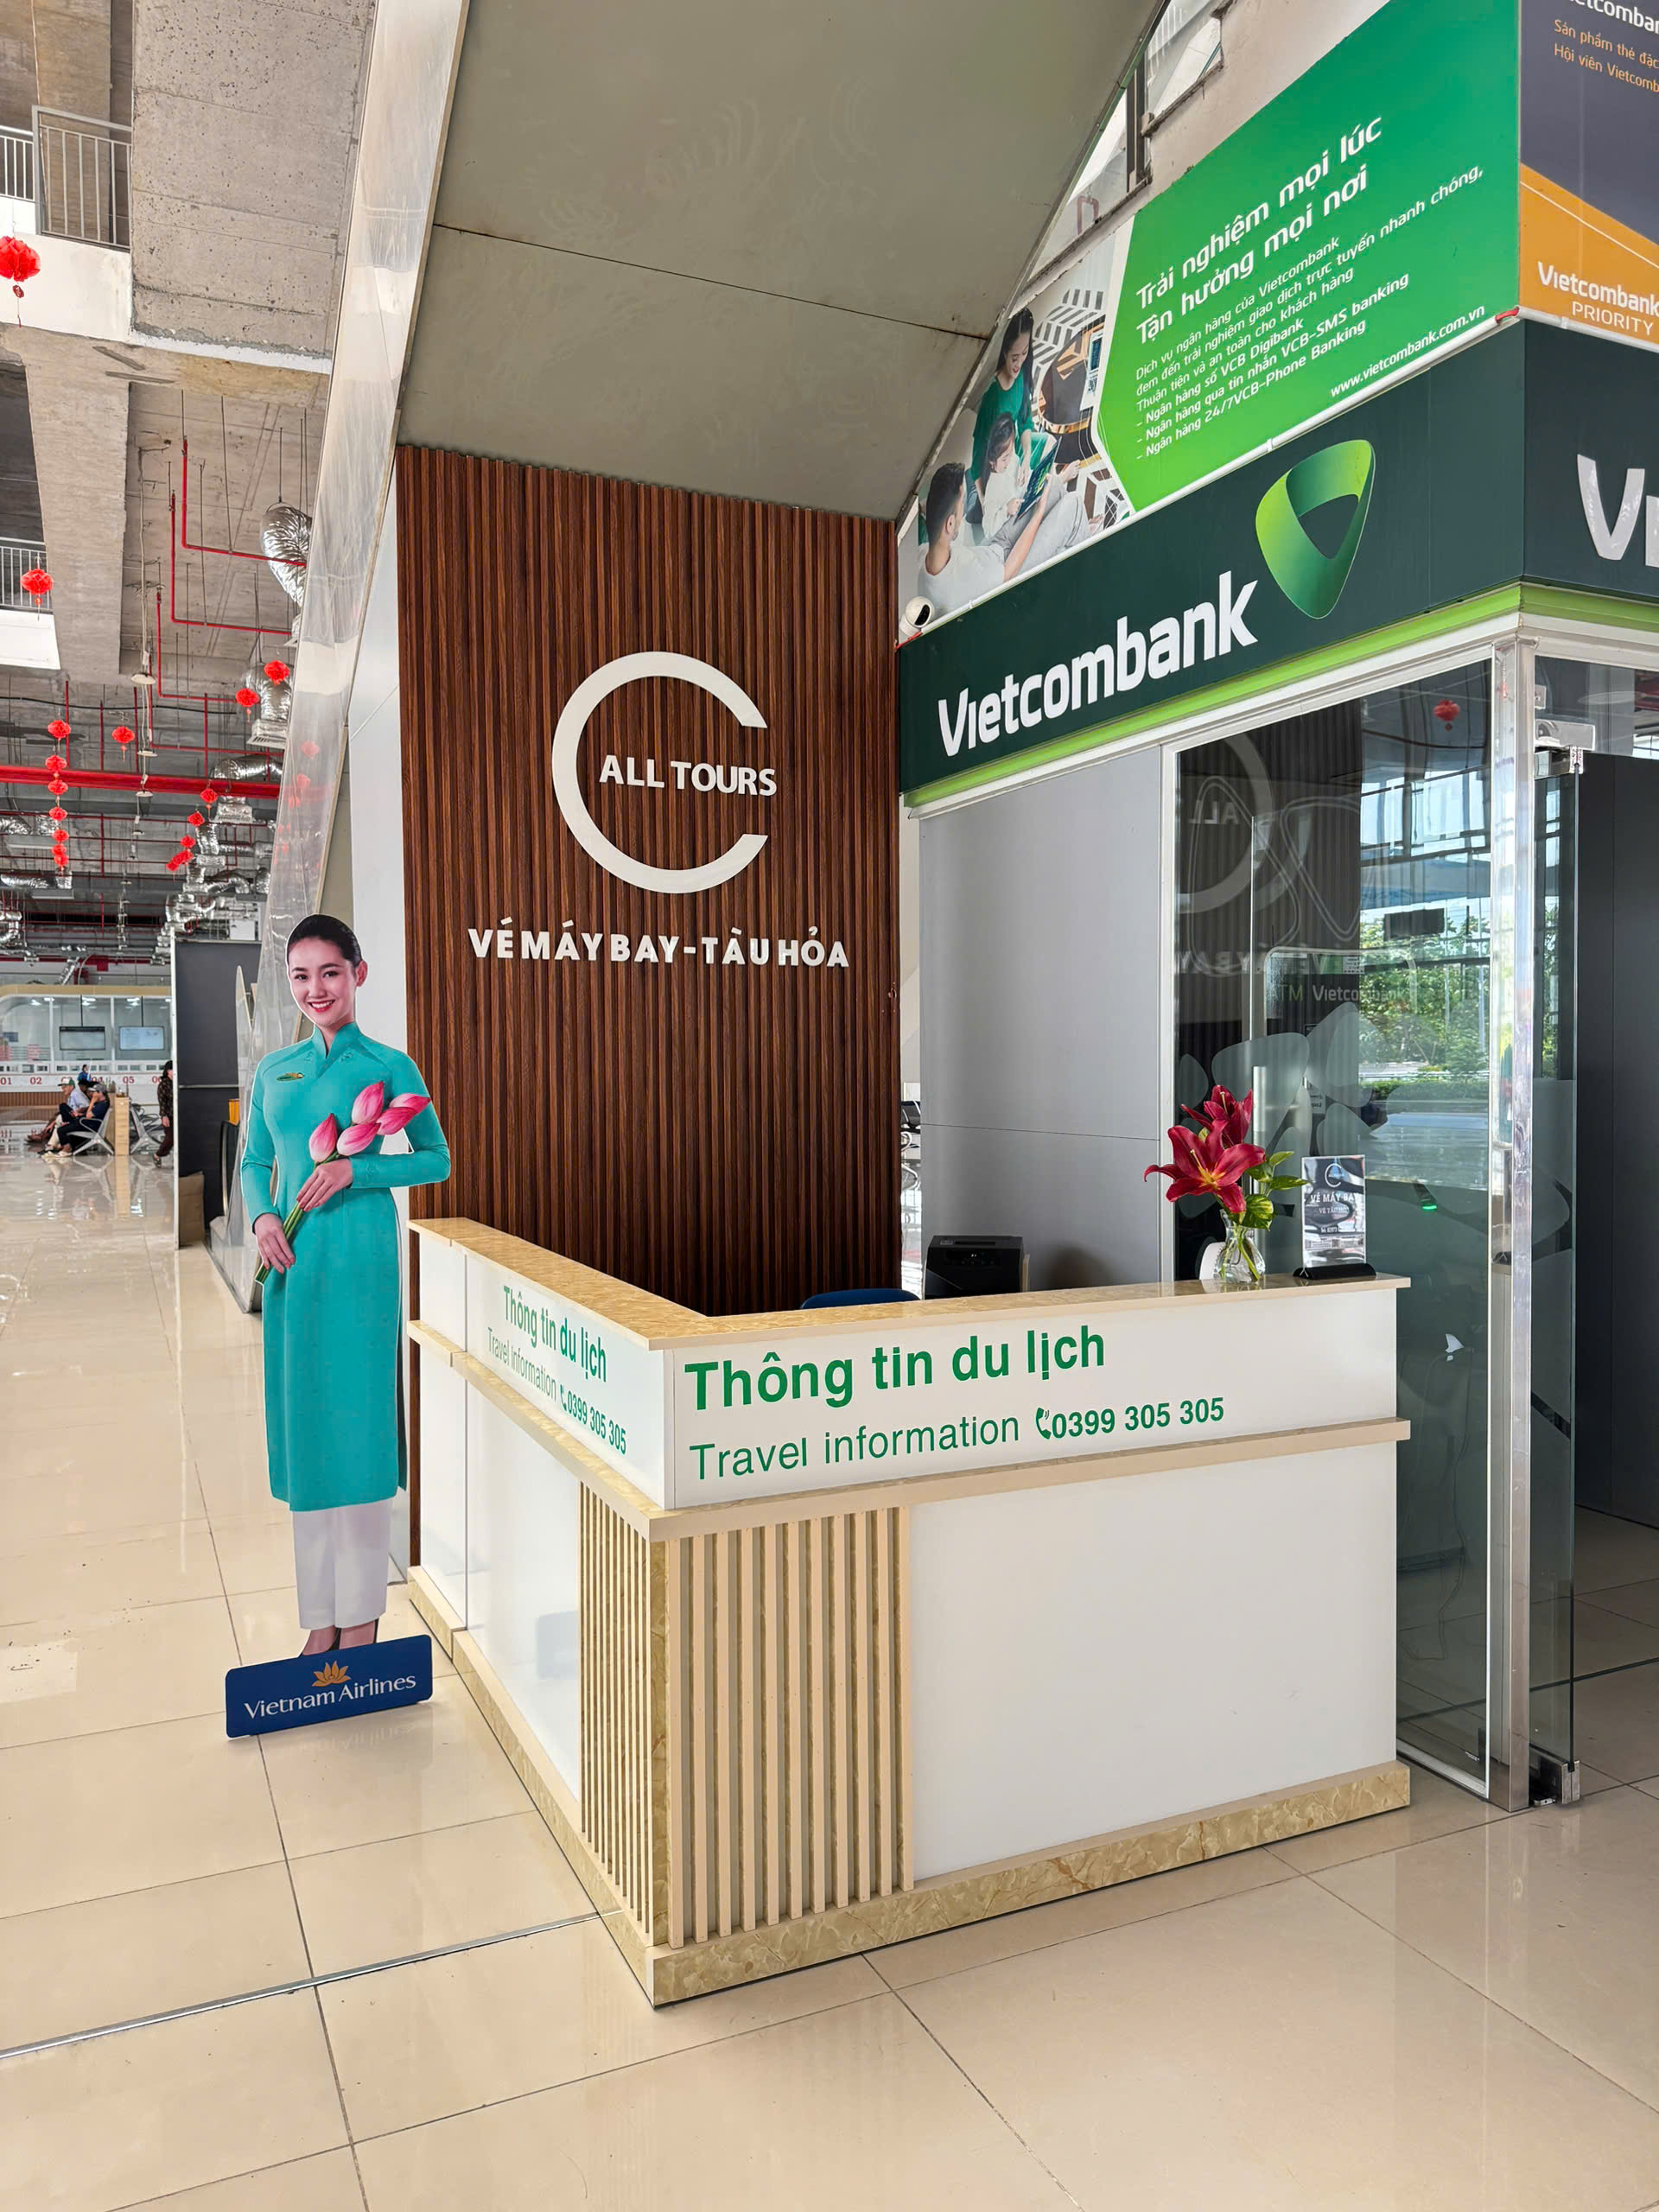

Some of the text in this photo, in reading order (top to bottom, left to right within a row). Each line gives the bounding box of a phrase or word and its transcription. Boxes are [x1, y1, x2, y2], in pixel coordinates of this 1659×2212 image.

[1554, 19, 1576, 39] Sản
[1580, 31, 1613, 52] phẩm
[1617, 43, 1636, 60] thẻ
[1554, 42, 1574, 62] Hội
[1578, 54, 1603, 73] viên
[1136, 117, 1382, 308] Trải nghiệm mọi lúc
[1136, 163, 1367, 344] Tận hưởng mọi nơi
[1136, 165, 1484, 396] đem đến trải nghiệm giao dịch trực tuyến nhanh chóng,
[1136, 237, 1339, 380] Dịch vụ ngân hàng của Vietcombank
[1537, 260, 1659, 317] Vietcombank
[1572, 301, 1654, 336] PRIORITY
[1136, 267, 1353, 411] Thuận tiện và an toàn cho khách hàng
[1146, 419, 1172, 441] Ngân
[1175, 400, 1201, 423] hàng
[1205, 386, 1224, 405] qua
[1228, 375, 1243, 391] tin
[1248, 354, 1277, 379] nhắn
[1351, 273, 1409, 316] banking
[1146, 402, 1172, 423] Ngân
[1175, 383, 1201, 406] hàng
[1205, 367, 1217, 388] số
[1221, 353, 1245, 376] VCB
[1250, 318, 1304, 359] Digibank
[1331, 305, 1485, 397] www.vietcombank.com.vn
[1146, 435, 1172, 457] Ngân
[1175, 417, 1201, 441] hàng
[1311, 320, 1366, 360] Banking
[938, 570, 1259, 757] Vietcombank
[599, 754, 778, 797] ALL TOURS
[467, 916, 513, 959] VÉ
[521, 919, 603, 962] MÁY
[610, 933, 679, 963] BAY
[701, 927, 769, 965] TÀU
[778, 926, 849, 968] HỎA
[1313, 984, 1408, 1002] Vietcobank
[29, 1077, 42, 1085] 02
[123, 1077, 135, 1085] 05
[504, 1285, 607, 1382] Thông tin du lịch
[684, 1325, 1106, 1411] Thông tin du lịch
[487, 1326, 626, 1455] Travel information 0399 305 305
[690, 1396, 1225, 1481] Travel information 0399 305 305
[244, 1675, 416, 1719] Vietnam Airlines
